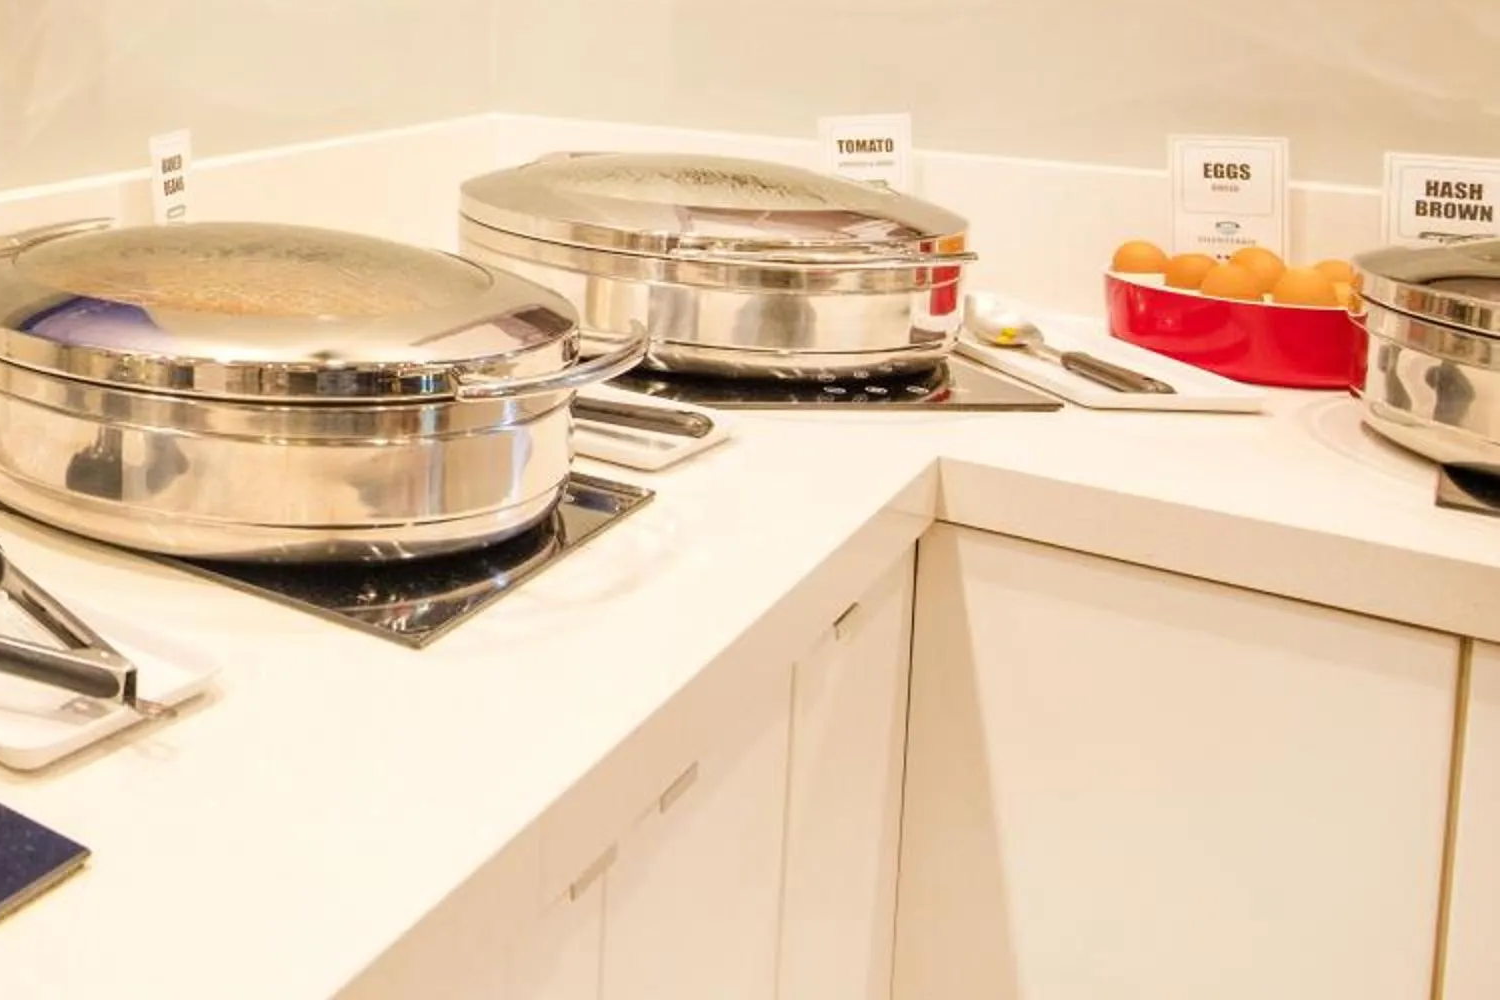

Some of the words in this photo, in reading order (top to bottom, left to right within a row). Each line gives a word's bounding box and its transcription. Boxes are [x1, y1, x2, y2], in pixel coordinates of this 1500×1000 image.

[836, 138, 894, 154] TOMATO
[1203, 162, 1251, 180] EGGS
[1425, 180, 1483, 200] HASH
[1415, 200, 1493, 222] BROWN
